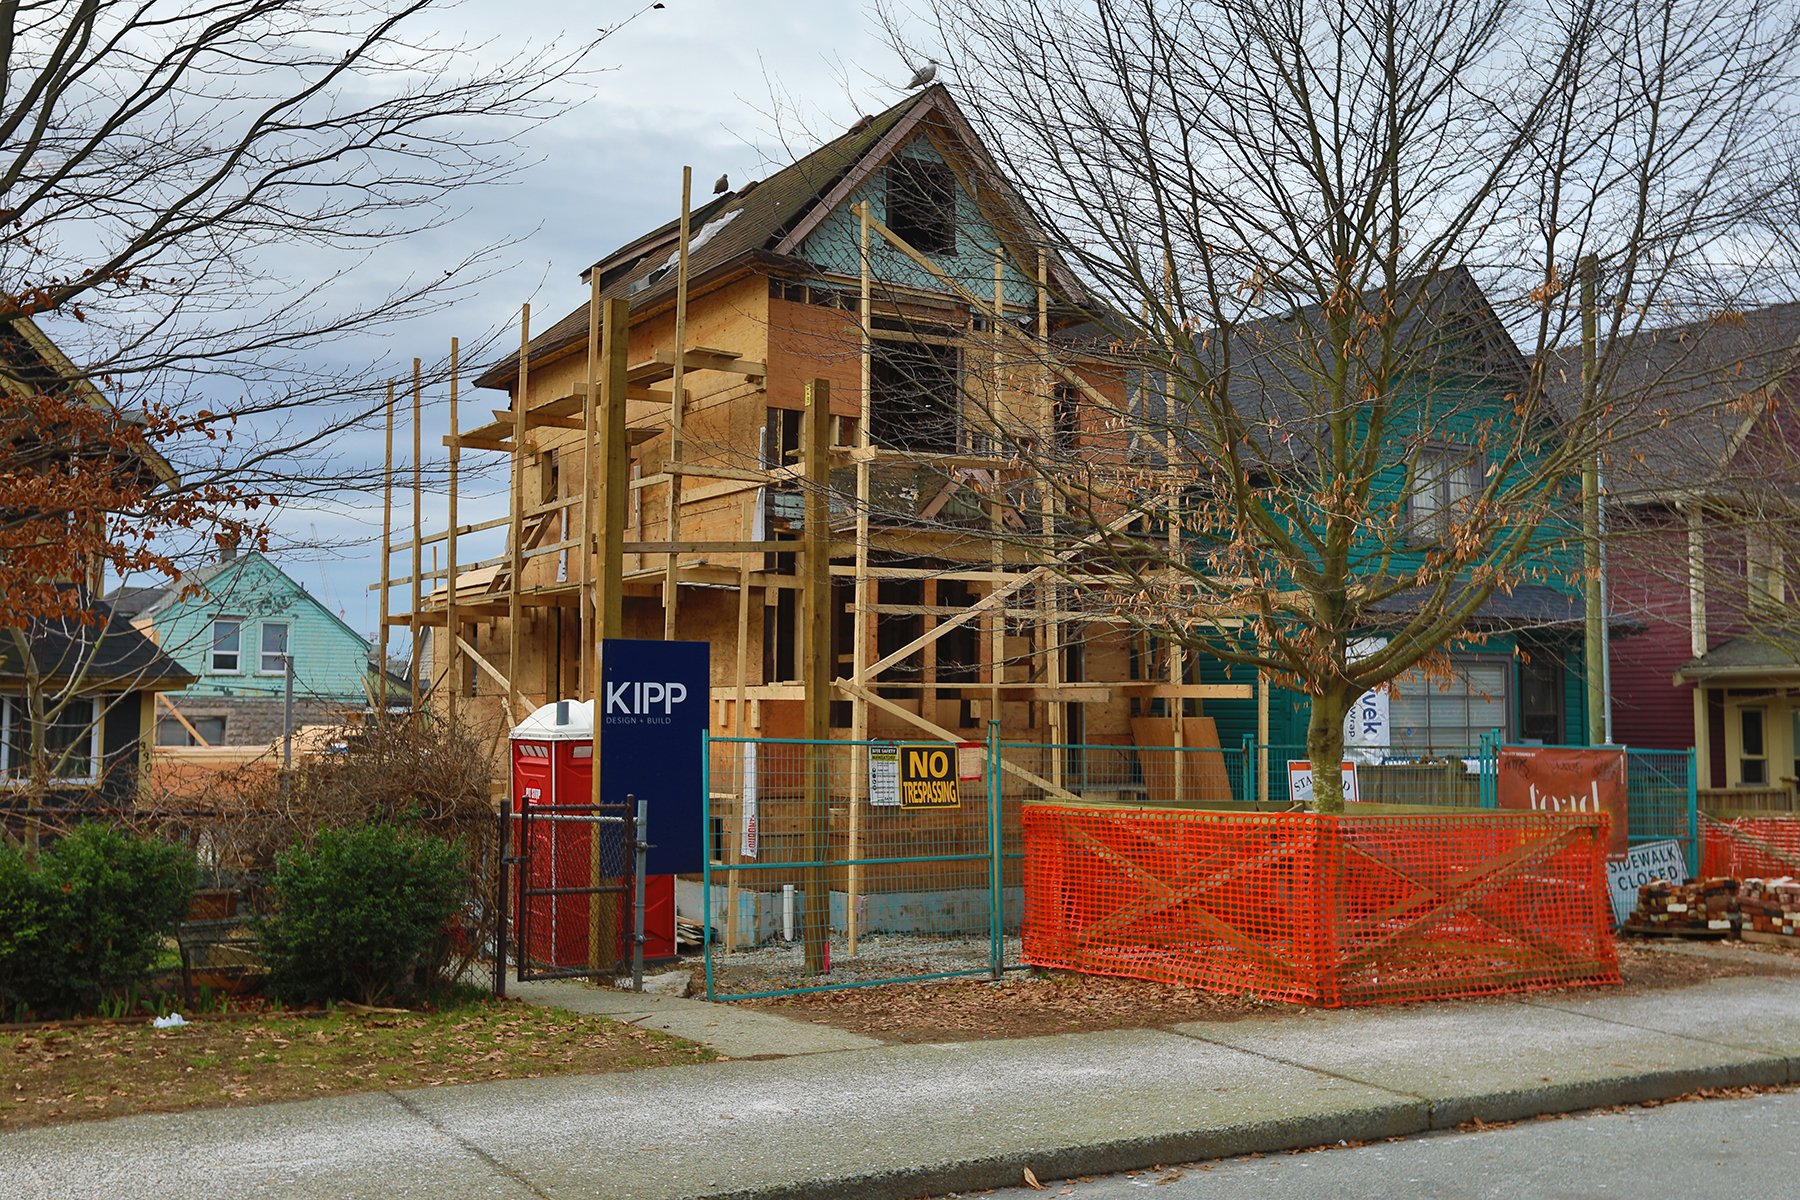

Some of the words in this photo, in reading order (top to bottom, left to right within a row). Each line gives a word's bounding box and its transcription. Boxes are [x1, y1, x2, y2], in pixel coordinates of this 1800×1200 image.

[606, 681, 687, 714] KIPP
[1362, 688, 1382, 734] vek
[606, 717, 637, 725] DESIGN
[647, 717, 672, 725] BUILD
[909, 751, 949, 779] NO
[903, 781, 957, 803] TRESPASSING
[1608, 846, 1677, 873] SIDEWALK
[1617, 865, 1678, 891] CLOSED
